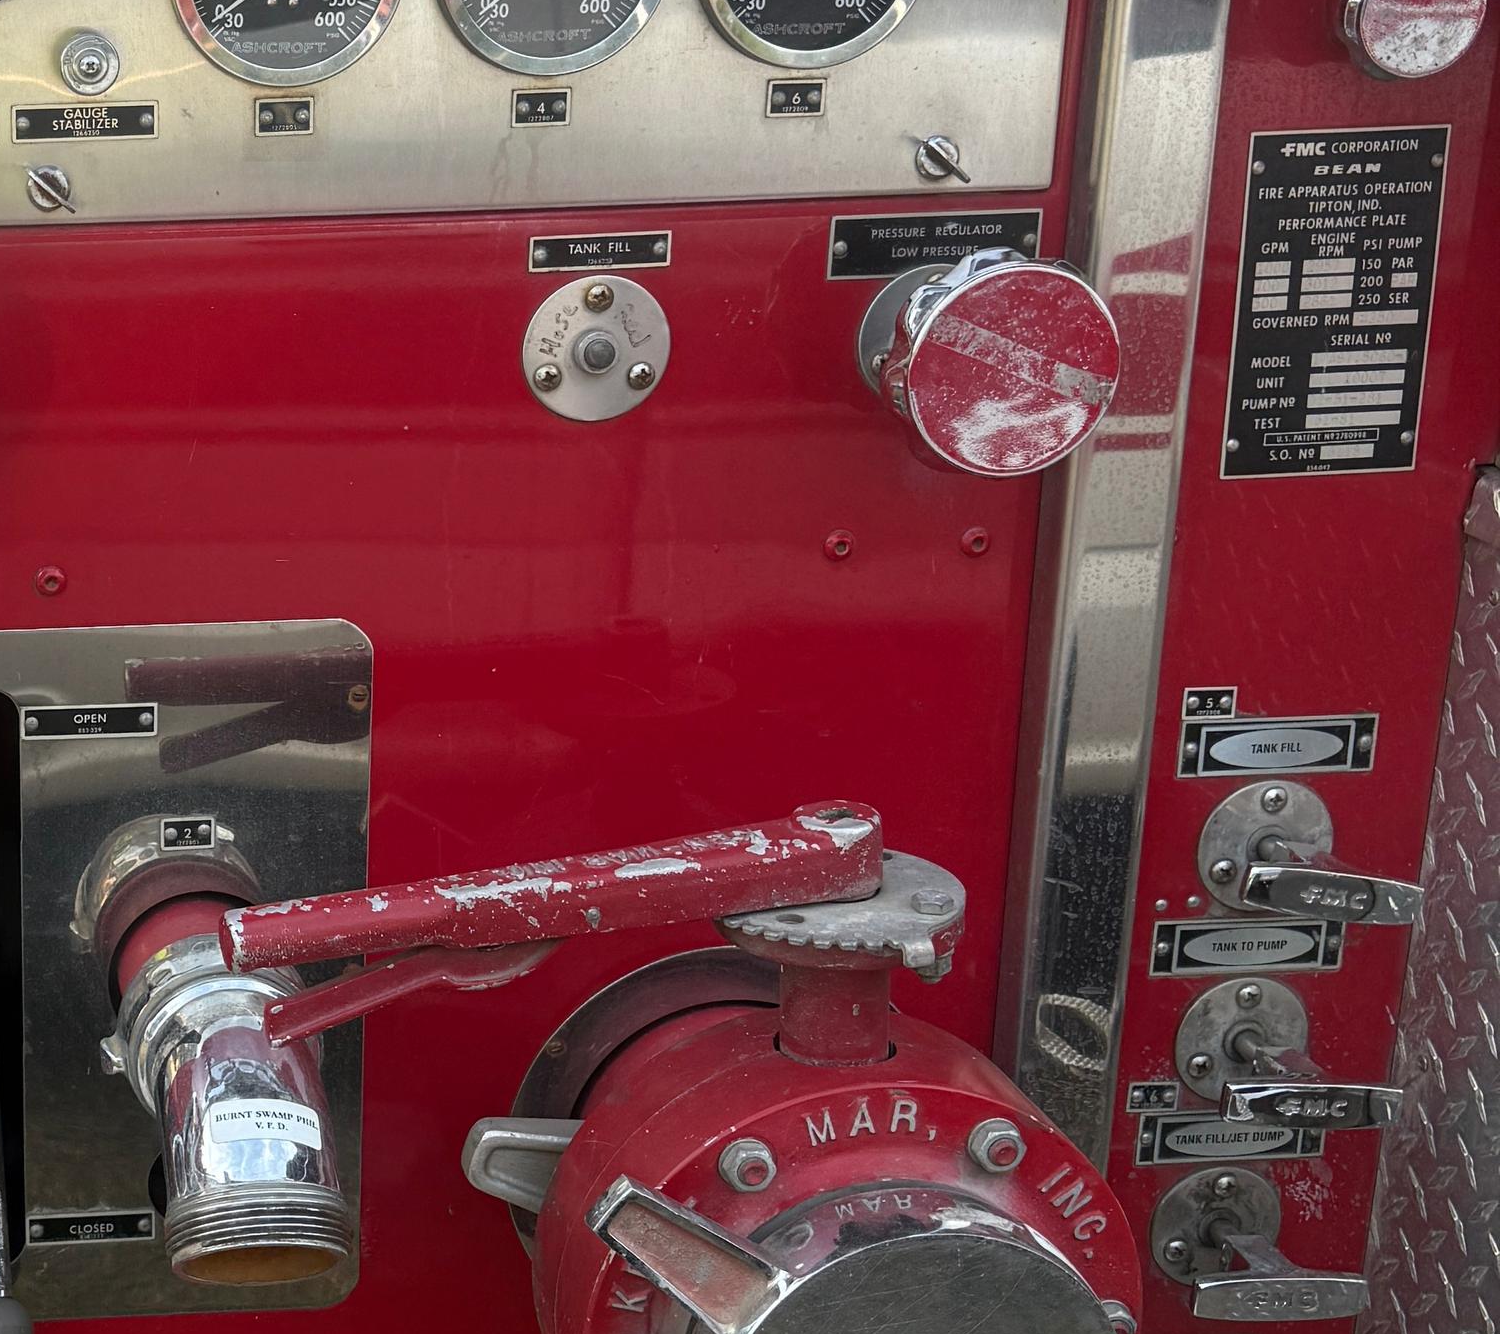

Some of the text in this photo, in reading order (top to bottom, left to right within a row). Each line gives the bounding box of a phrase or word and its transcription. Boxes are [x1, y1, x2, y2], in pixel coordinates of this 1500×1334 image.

[792, 91, 801, 106] 6
[64, 108, 108, 118] GAUGE
[536, 101, 546, 115] 4
[53, 118, 118, 130] STABILIZER
[1281, 139, 1418, 157] FMC CORPORATION
[1314, 163, 1381, 175] BEAN
[1259, 181, 1432, 199] FIRE APPARATUS OPERATION
[1357, 199, 1382, 211] IND.
[1278, 215, 1406, 231] PERFORMANCE PLATE
[872, 224, 1002, 239] PRESSURE REGULATOR
[1311, 233, 1356, 245] ENGINE
[1363, 237, 1422, 250] PSI PUMP
[568, 241, 631, 255] TANK FILL
[892, 247, 919, 257] LOW
[1261, 243, 1289, 254] GPM
[1319, 245, 1344, 256] RPM
[1362, 259, 1381, 270] 150
[1392, 258, 1413, 269] PAR
[1360, 276, 1383, 287] 200
[1358, 293, 1380, 305] 250
[1389, 293, 1409, 304] SER
[1252, 316, 1318, 329] GOVERNED
[1324, 315, 1349, 326] RPM
[1331, 334, 1370, 346] SERIAL
[1251, 356, 1291, 368] MODEL
[1256, 377, 1284, 388] UNIT
[1242, 398, 1276, 410] PUMP
[1254, 418, 1281, 429] TEST
[1293, 434, 1321, 442] PATENT
[1205, 698, 1213, 709] 5
[73, 712, 107, 725] OPEN
[1252, 743, 1302, 753] TANK FILL
[184, 828, 192, 838] 2
[1212, 940, 1288, 952] TANK TO PUMP
[216, 1111, 252, 1122] BURNT
[256, 1110, 293, 1120] SWAMP
[1175, 1131, 1284, 1144] TANK FILL/JET DUMP
[69, 1223, 114, 1235] CLOSED
